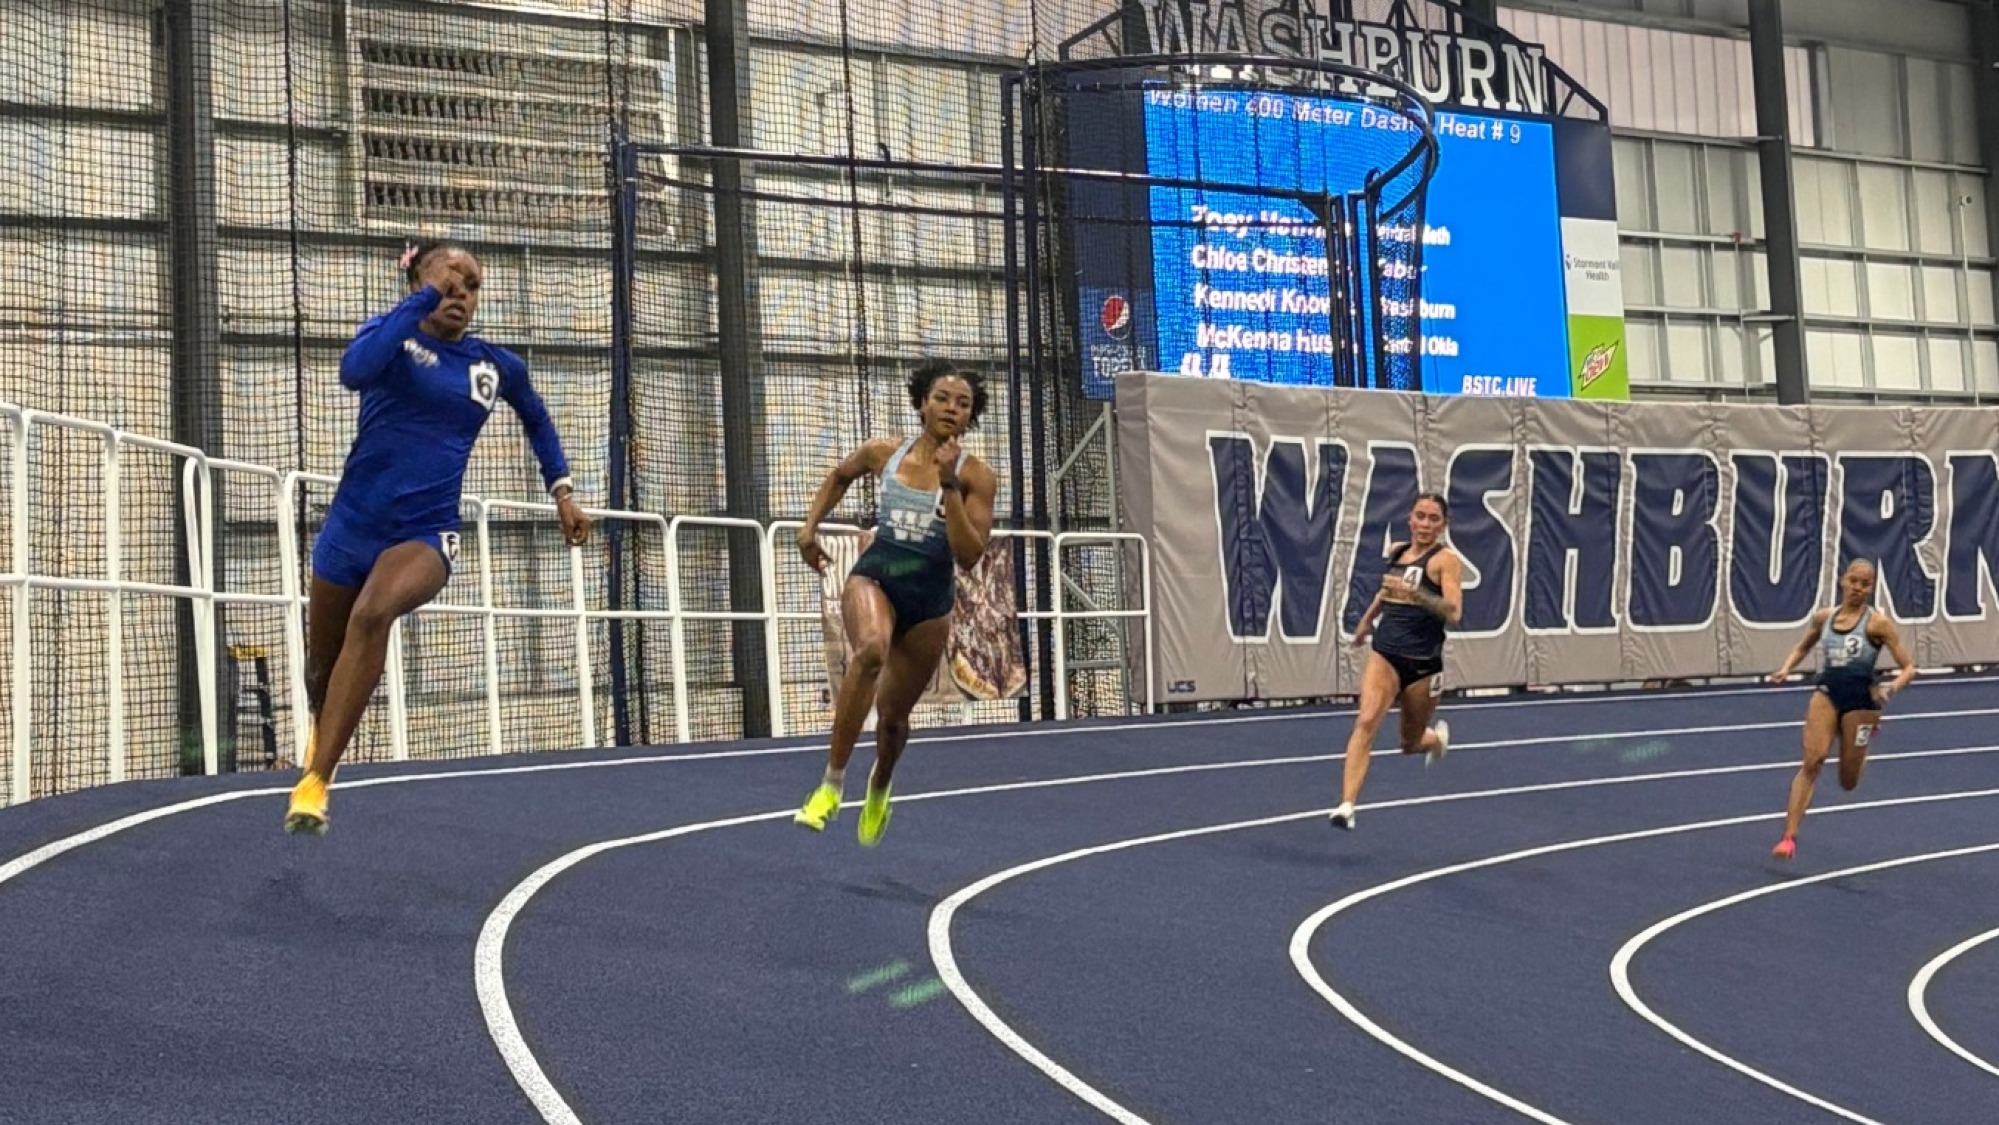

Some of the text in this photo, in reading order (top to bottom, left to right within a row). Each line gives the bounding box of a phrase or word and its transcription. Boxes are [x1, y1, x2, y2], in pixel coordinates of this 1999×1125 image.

[1140, 0, 1545, 114] WASHBURN
[1150, 88, 1238, 113] Women
[1293, 101, 1354, 127] Meter
[1361, 107, 1414, 131] Dash
[1439, 114, 1486, 140] Heat
[1492, 123, 1503, 141] #
[1509, 123, 1521, 144] 9
[1192, 244, 1248, 272] Chloe
[1194, 282, 1276, 311] Kennedi
[1196, 322, 1292, 351] McKenna
[475, 372, 494, 401] 6
[1462, 373, 1538, 396] BSTC.LIVE
[1403, 568, 1418, 589] 4
[1846, 637, 1859, 655] 3
[1167, 680, 1196, 693] UCS
